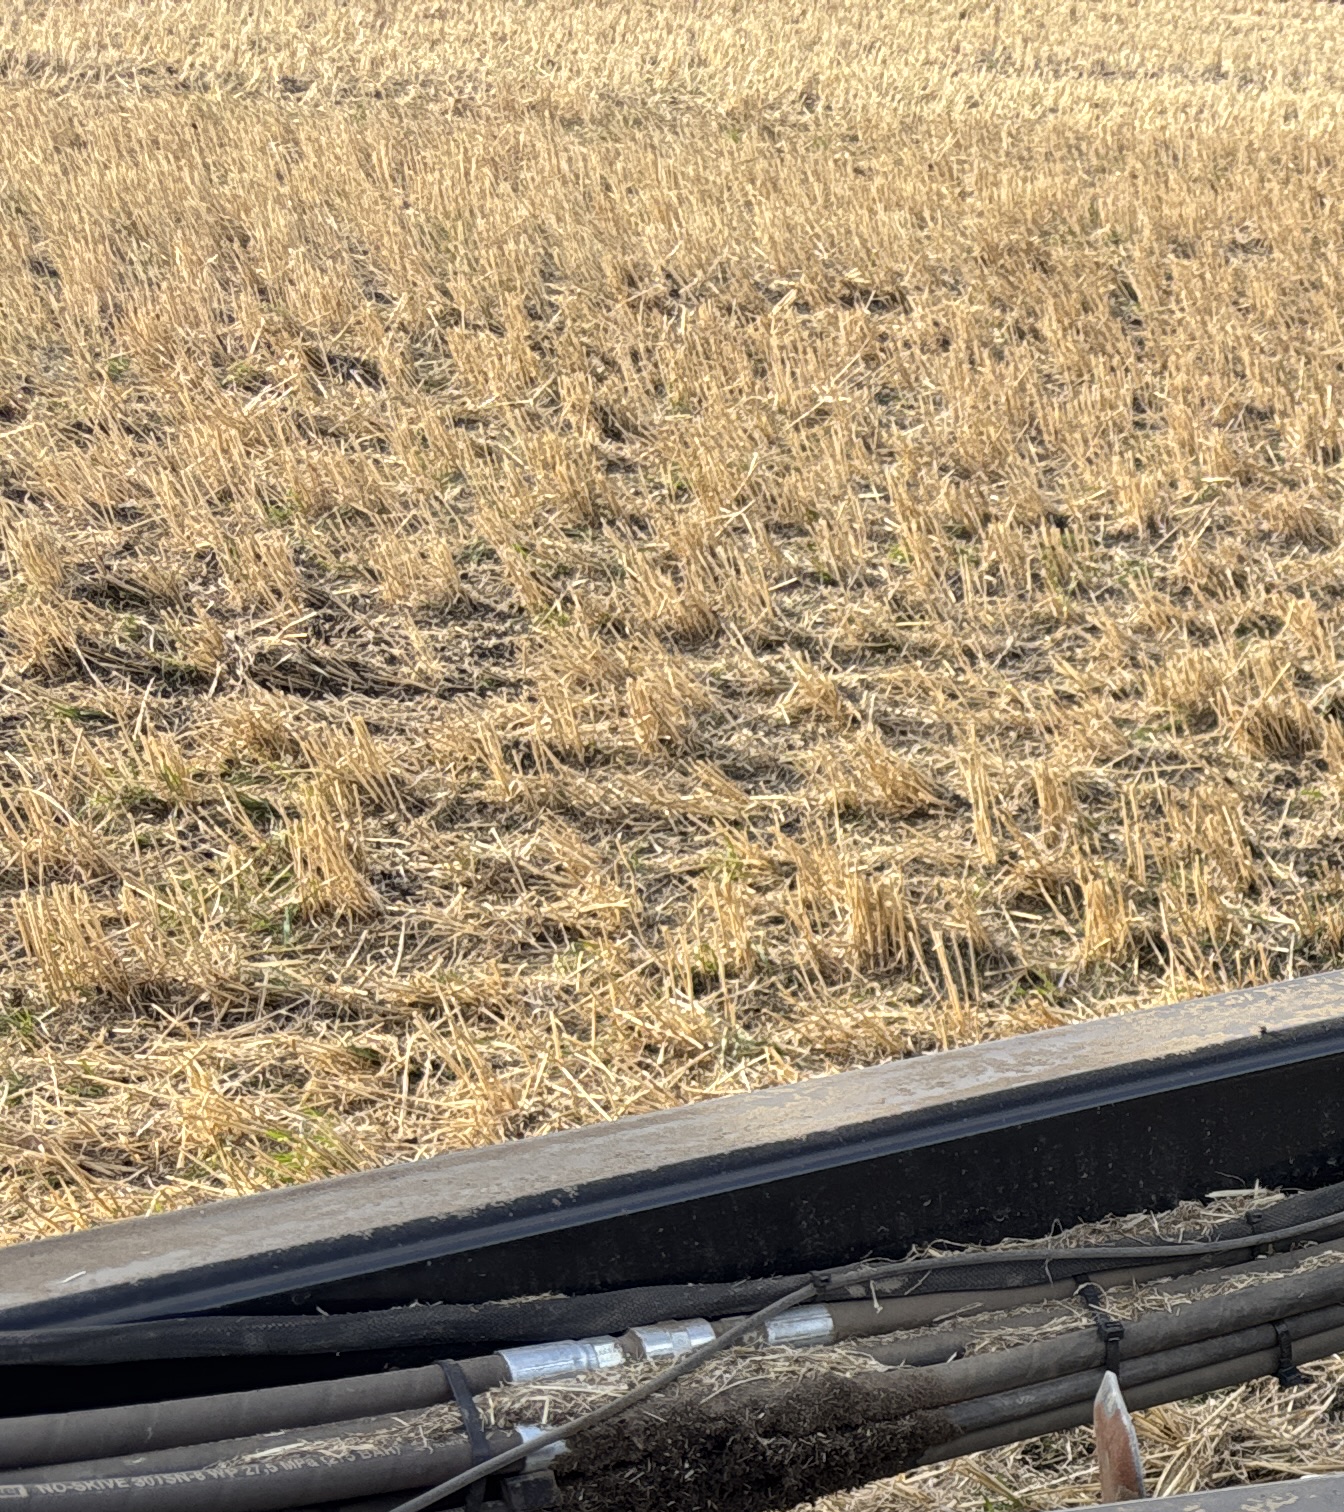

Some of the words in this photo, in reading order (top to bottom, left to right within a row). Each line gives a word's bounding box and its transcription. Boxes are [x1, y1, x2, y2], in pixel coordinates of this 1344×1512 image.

[35, 1476, 131, 1495] NO-SKIVE
[244, 1462, 279, 1476] 27,5
[279, 1456, 320, 1471] MPa
